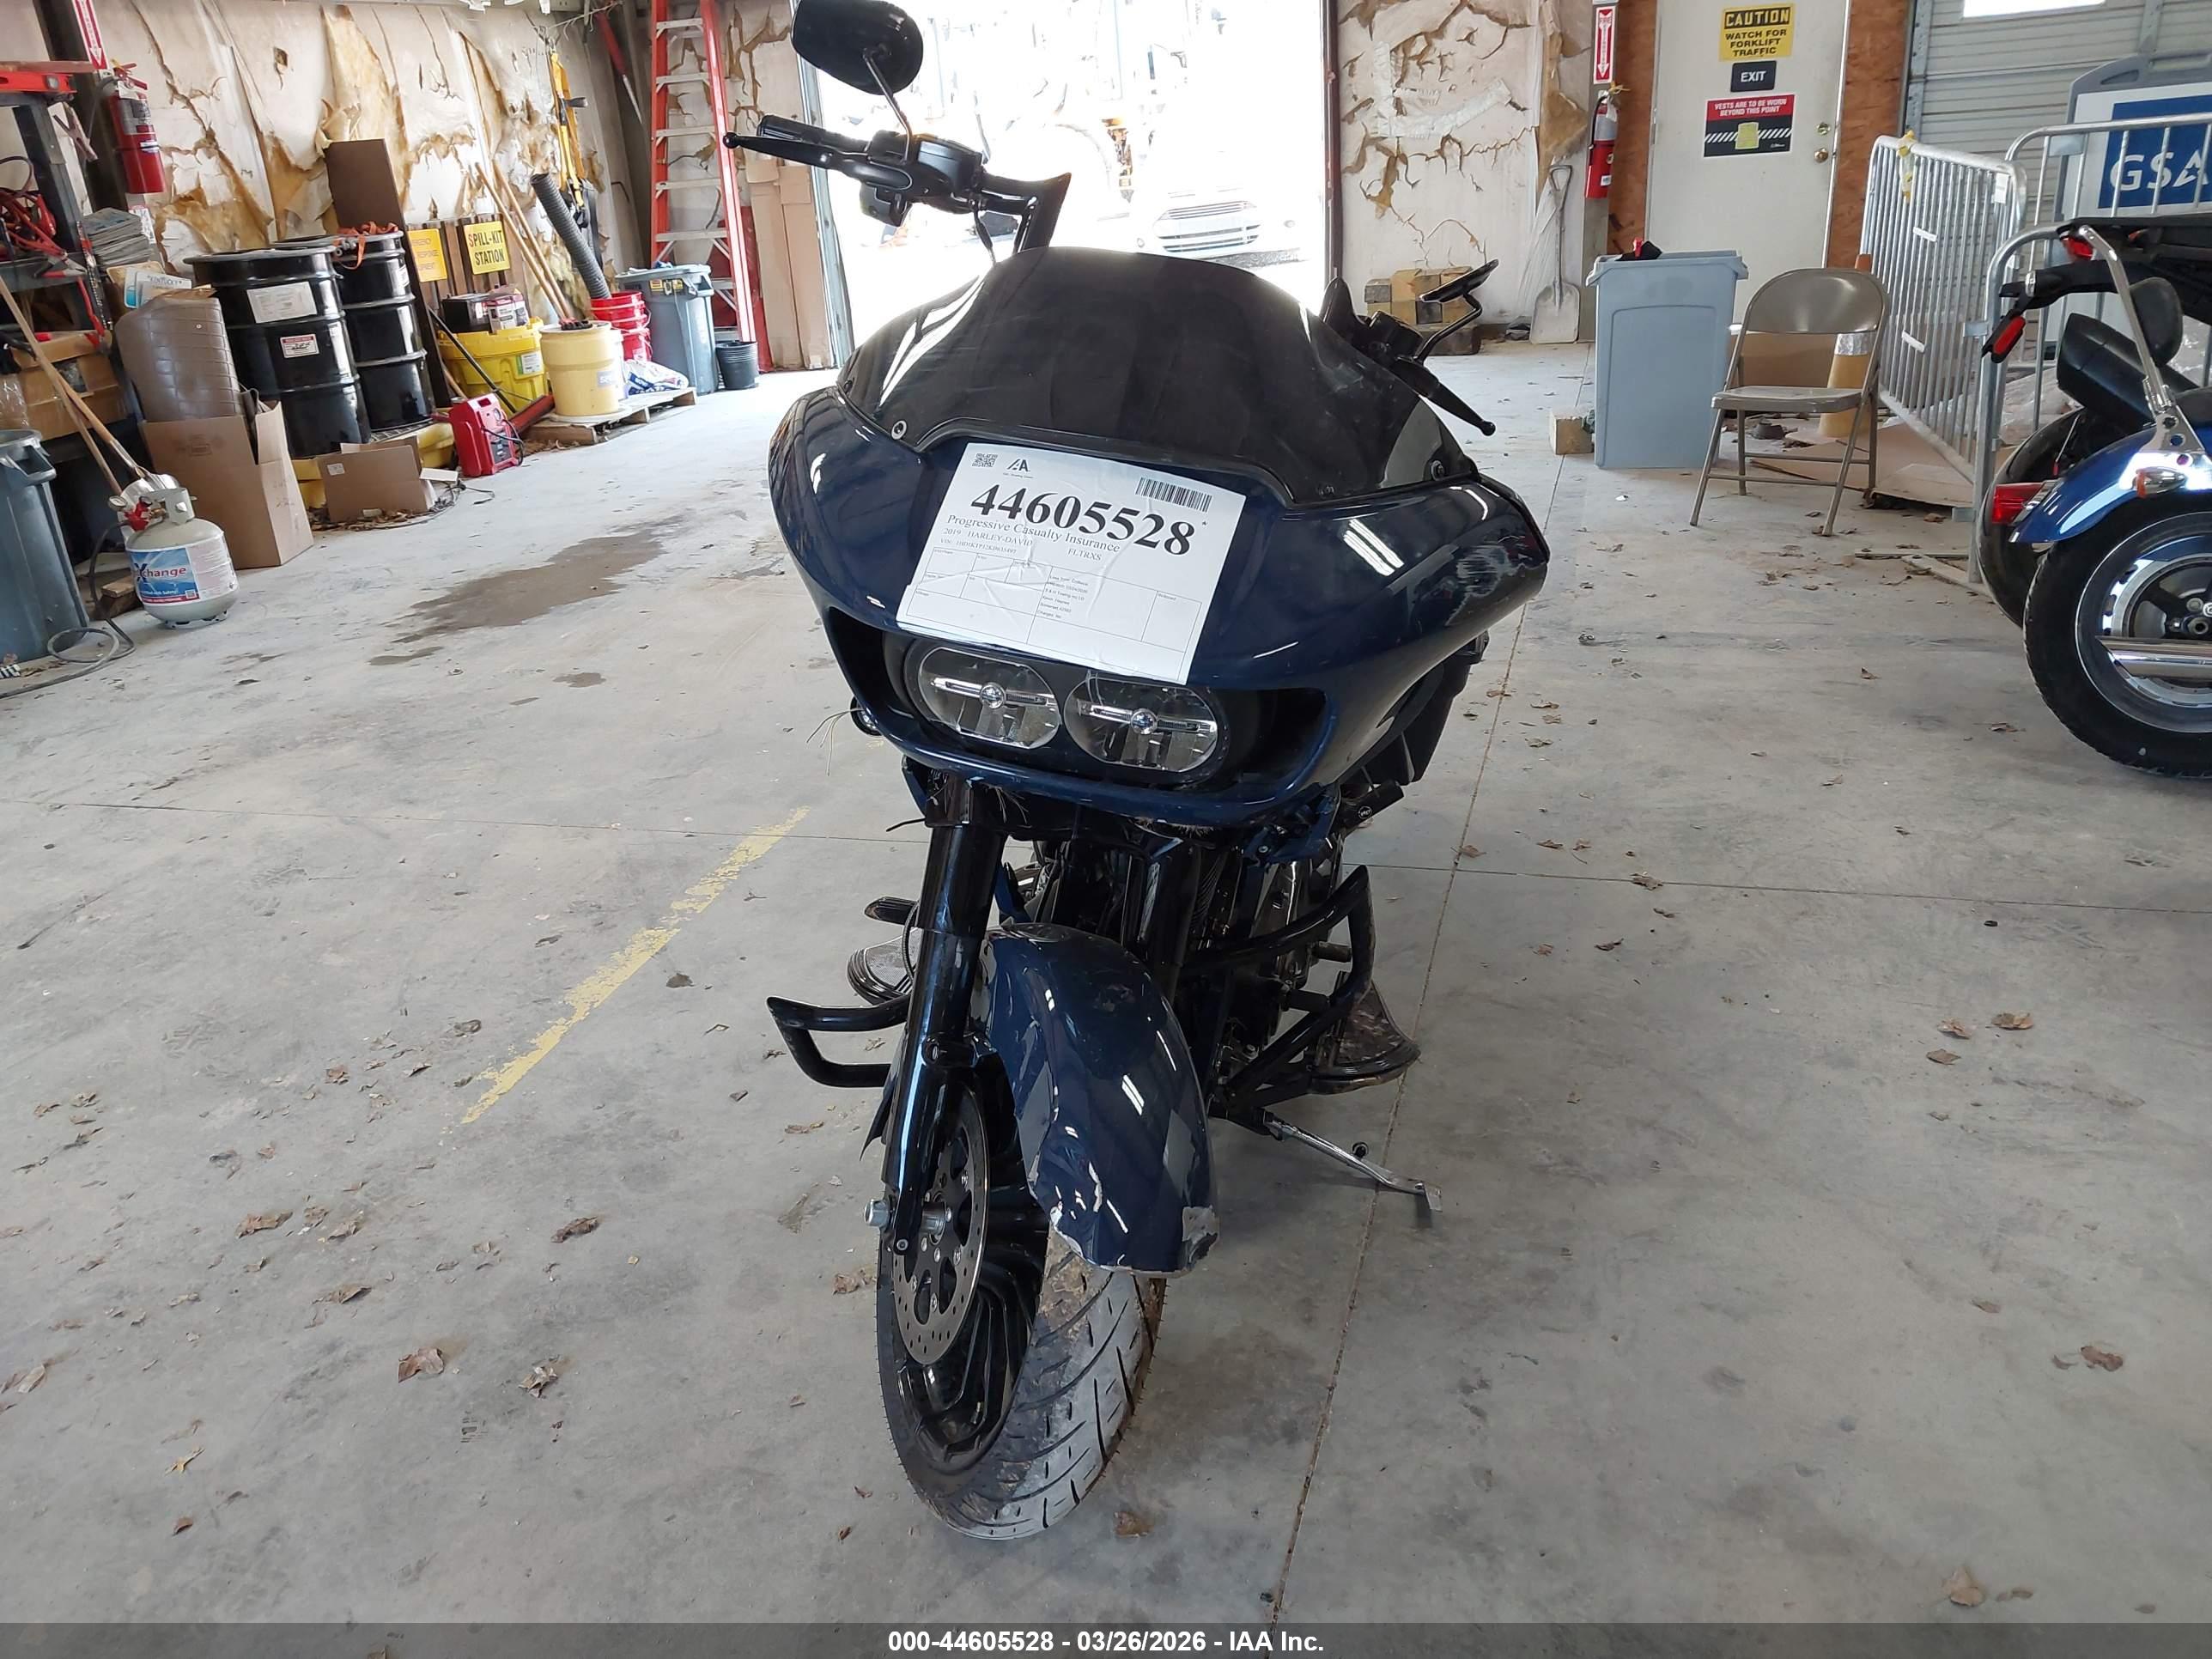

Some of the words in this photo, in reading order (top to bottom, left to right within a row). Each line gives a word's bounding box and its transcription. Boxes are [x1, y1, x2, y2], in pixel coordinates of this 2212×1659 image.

[1726, 9, 1789, 27] CAUTION
[1726, 31, 1762, 40] WATCH
[1730, 38, 1780, 48] FORKLIFT
[1733, 47, 1777, 57] TRAFFIC
[1741, 70, 1766, 82] EXIT
[1714, 102, 1734, 111] VESTS
[1719, 108, 1745, 117] BEYOND
[2110, 149, 2209, 191] GSA
[468, 230, 503, 247] SPILL-KIT
[474, 249, 505, 266] STATION
[970, 484, 1194, 555] 44605528
[947, 515, 1011, 532] Progressive
[1013, 523, 1062, 542] Casualty
[1066, 532, 1121, 552] Insurance
[968, 532, 1033, 546] HARLEY-DAVID
[1067, 549, 1102, 561] FLTRXS
